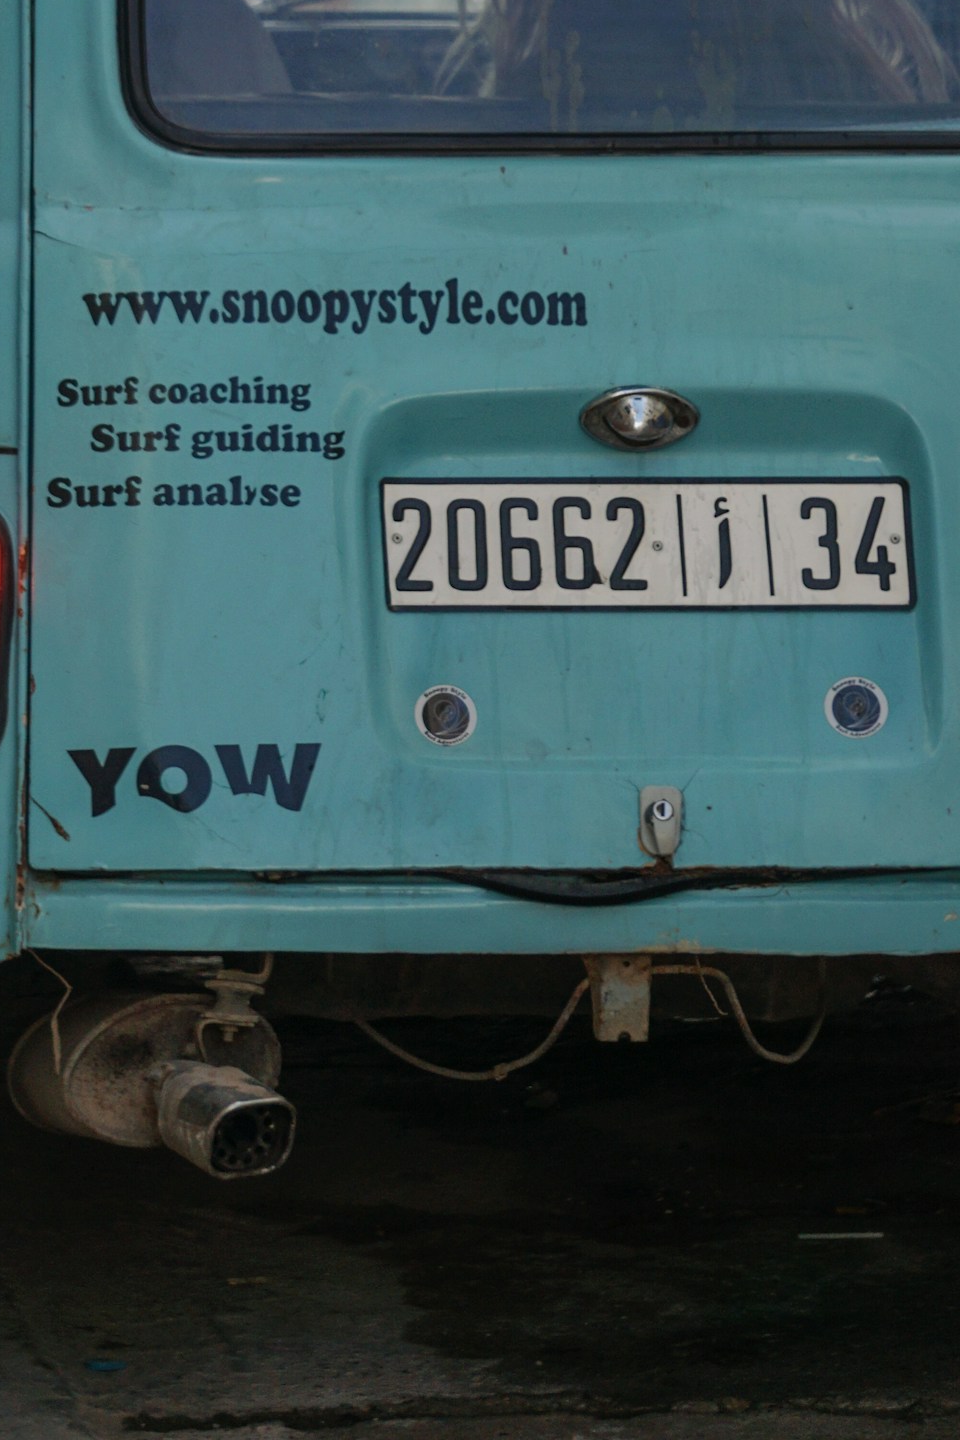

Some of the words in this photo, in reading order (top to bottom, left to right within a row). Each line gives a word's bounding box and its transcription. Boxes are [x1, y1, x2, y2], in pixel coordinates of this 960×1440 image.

[82, 278, 588, 335] www.snoopystyle.com
[56, 376, 139, 407] Surf
[148, 376, 311, 412] coaching
[90, 423, 181, 453] Surf
[191, 423, 346, 460] guiding
[46, 476, 142, 508] Surf
[392, 496, 648, 592] 20662
[800, 496, 897, 592] 34
[66, 743, 321, 818] YOW
